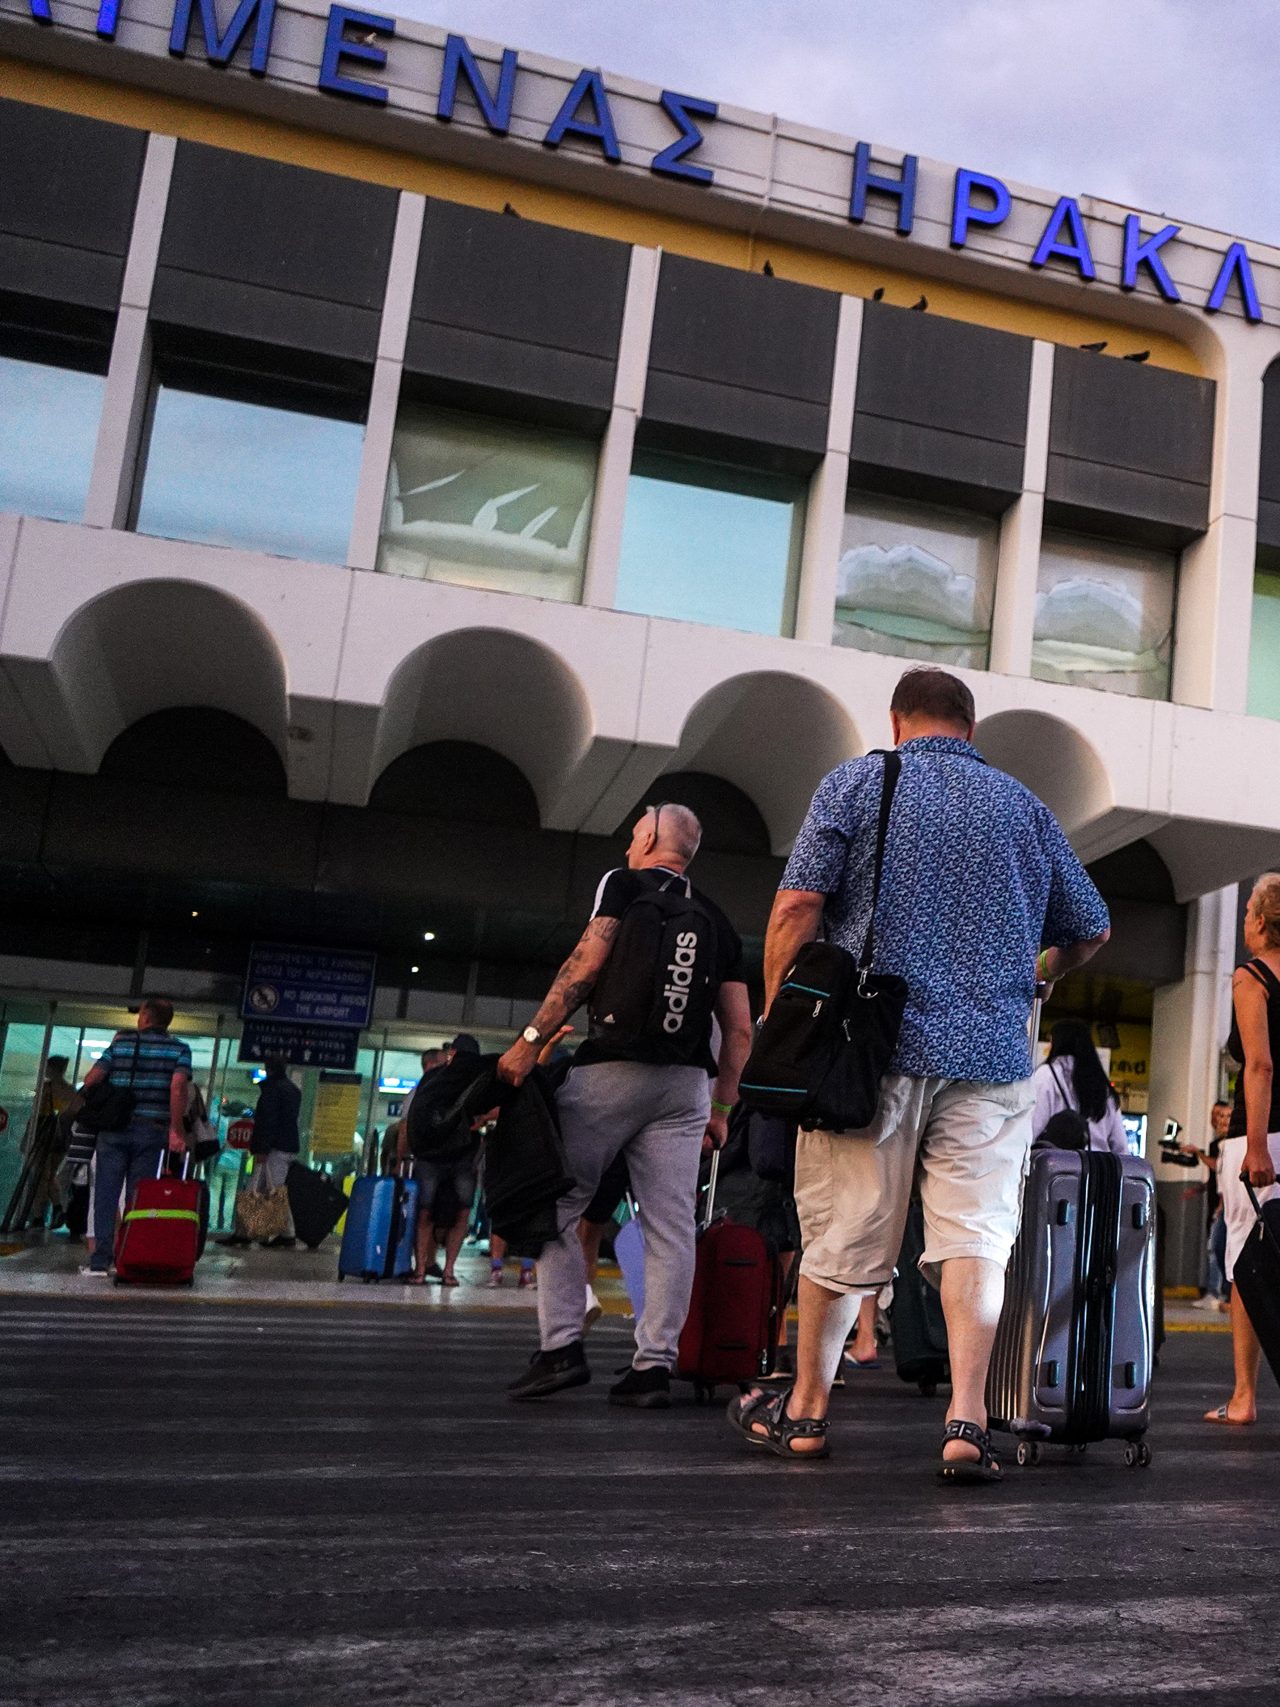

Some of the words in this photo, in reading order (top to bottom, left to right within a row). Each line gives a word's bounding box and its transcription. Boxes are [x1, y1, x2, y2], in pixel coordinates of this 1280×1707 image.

[31, 0, 718, 185] ΜΕΝΑΣ
[662, 931, 698, 1034] adidas
[229, 1128, 253, 1142] STO
